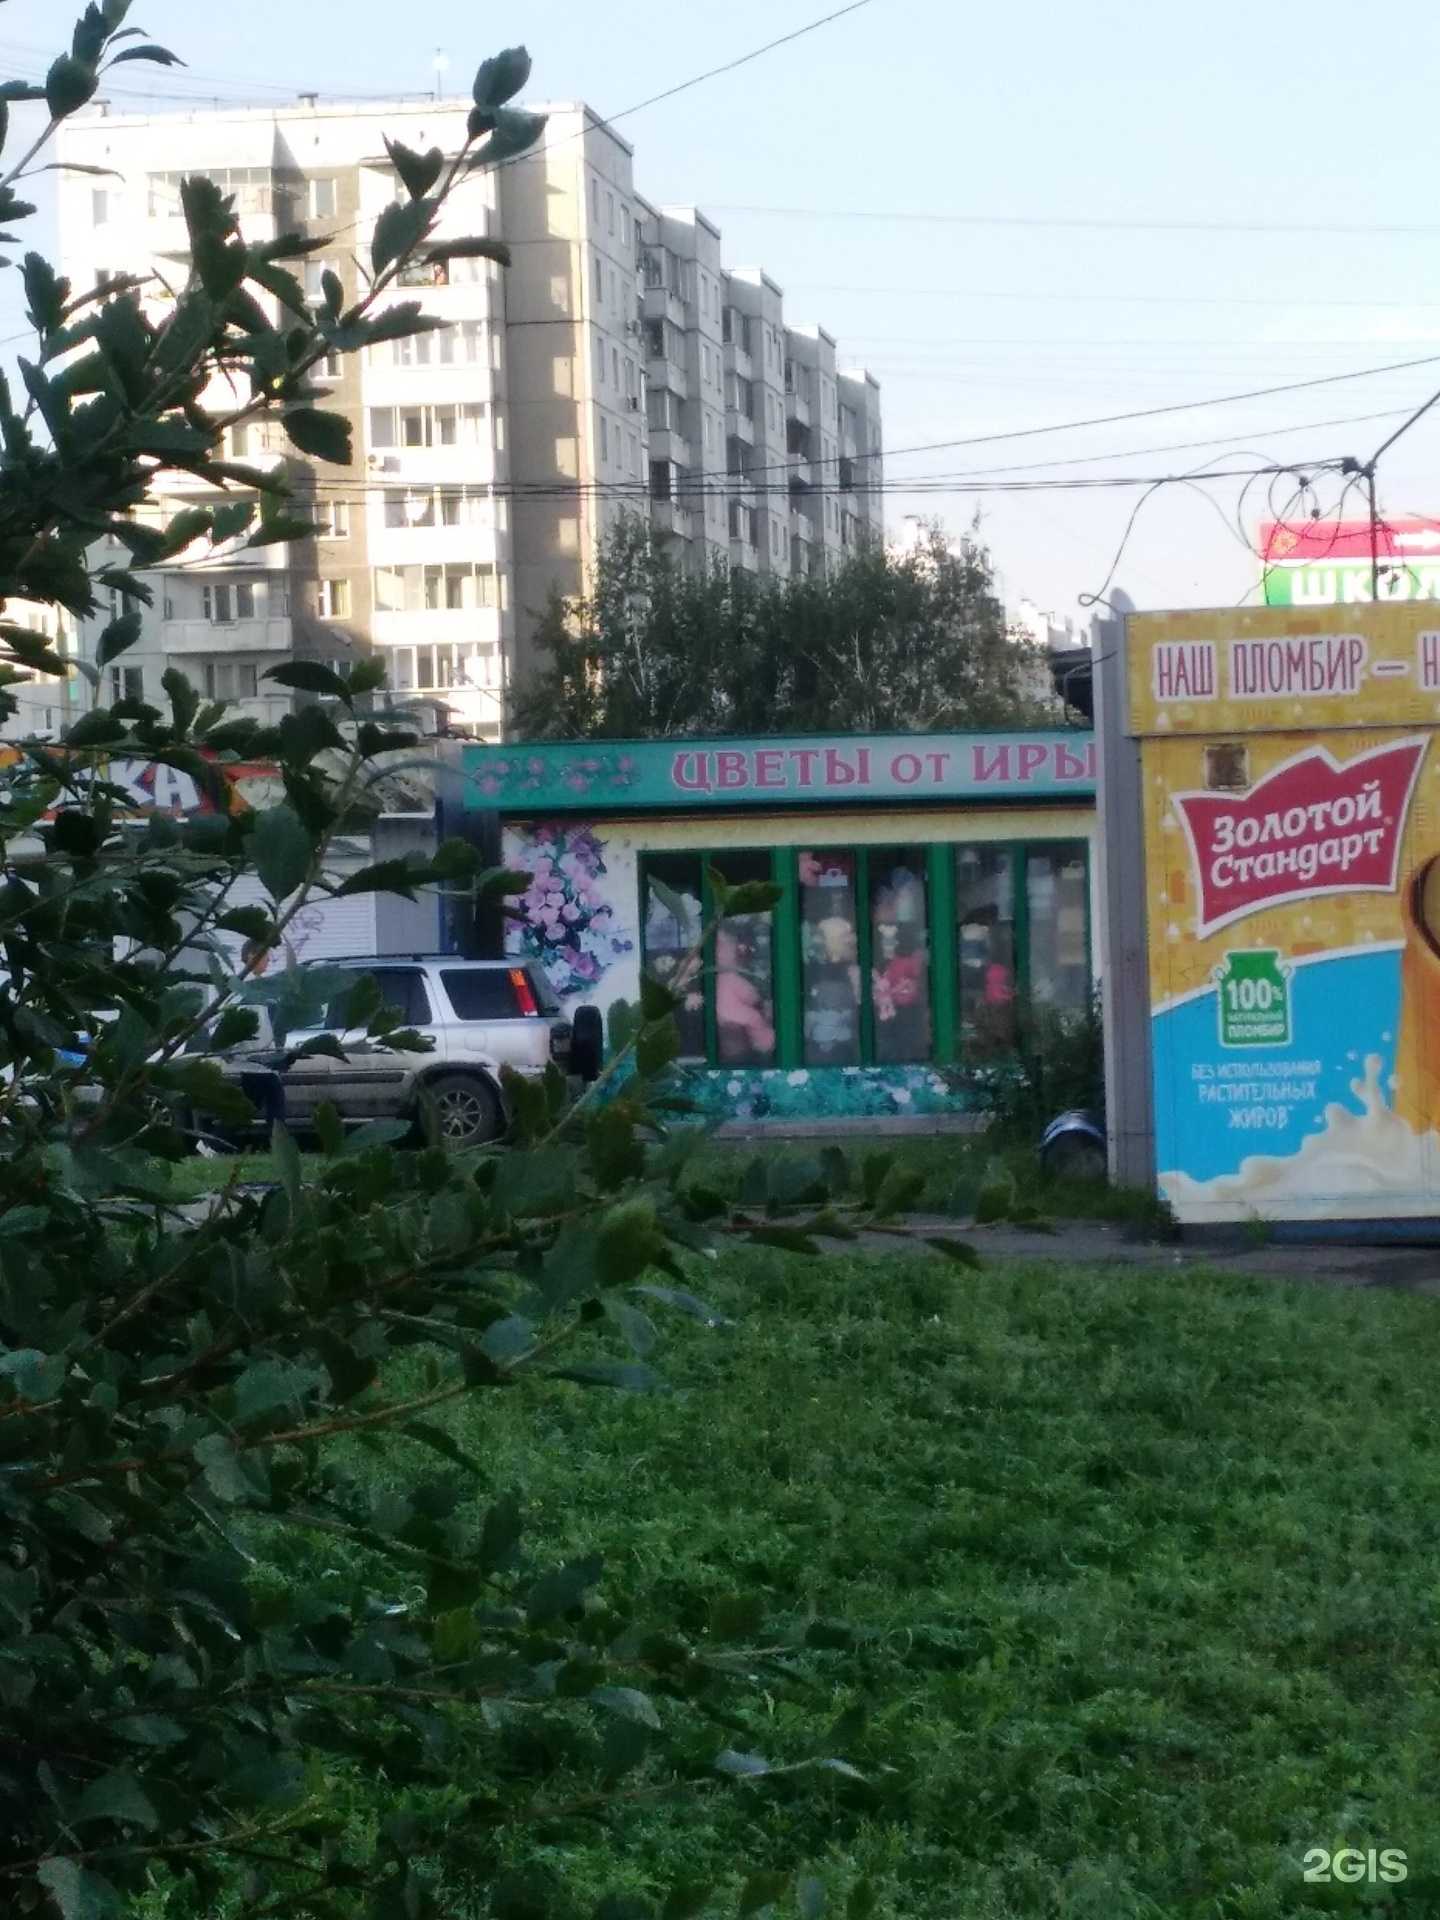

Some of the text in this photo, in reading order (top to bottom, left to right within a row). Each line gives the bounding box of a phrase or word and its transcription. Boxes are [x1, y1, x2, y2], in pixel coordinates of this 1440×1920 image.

[1157, 644, 1213, 697] НАШ
[1233, 637, 1364, 694] ПЛОМБИР
[672, 748, 871, 793] ЦВЕТЫ
[971, 742, 1097, 783] ИРЫ
[1210, 828, 1385, 888] Стандарт
[1227, 978, 1284, 1010] 100%
[1191, 1063, 1216, 1080] БЕЗ
[1198, 1081, 1317, 1103] РАСТИТЕЛЬНЫХ
